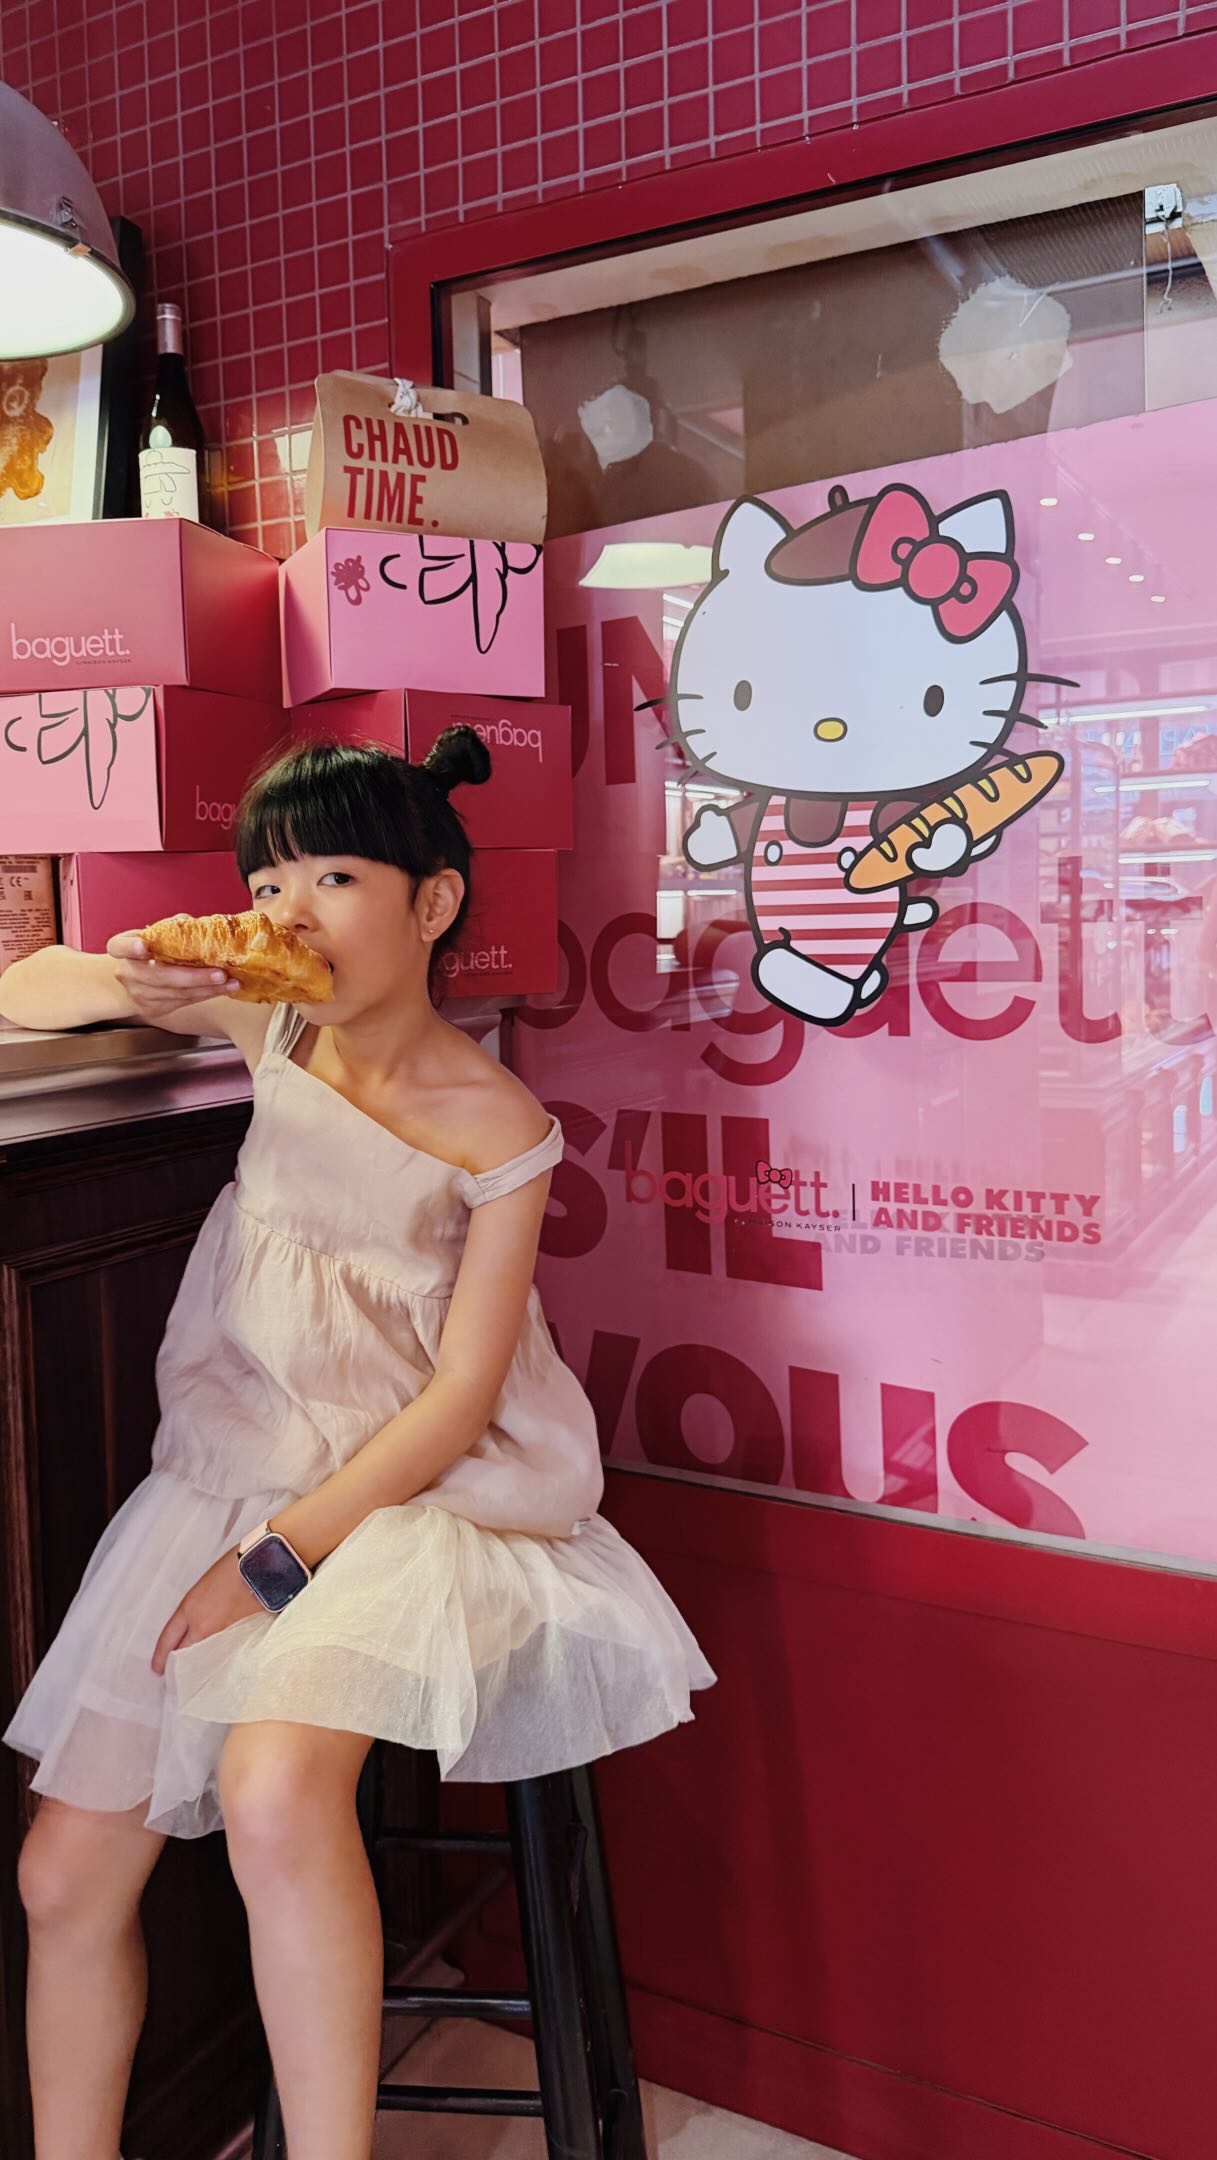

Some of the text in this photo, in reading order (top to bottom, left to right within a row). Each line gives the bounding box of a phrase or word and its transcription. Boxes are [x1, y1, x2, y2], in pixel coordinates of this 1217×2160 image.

[343, 414, 459, 471] CHAUD
[343, 465, 439, 528] TIME.
[10, 622, 130, 666] baguett.
[452, 719, 543, 764] bague
[443, 944, 513, 978] guett.
[625, 1140, 840, 1225] baguett.
[870, 1181, 974, 1208] HELLO
[985, 1188, 1101, 1217] KITTY
[796, 1222, 842, 1233] KAYSER
[871, 1207, 943, 1232] AND
[957, 1212, 1102, 1245] FRIENDS
[896, 1236, 1047, 1263] FRIENDS
